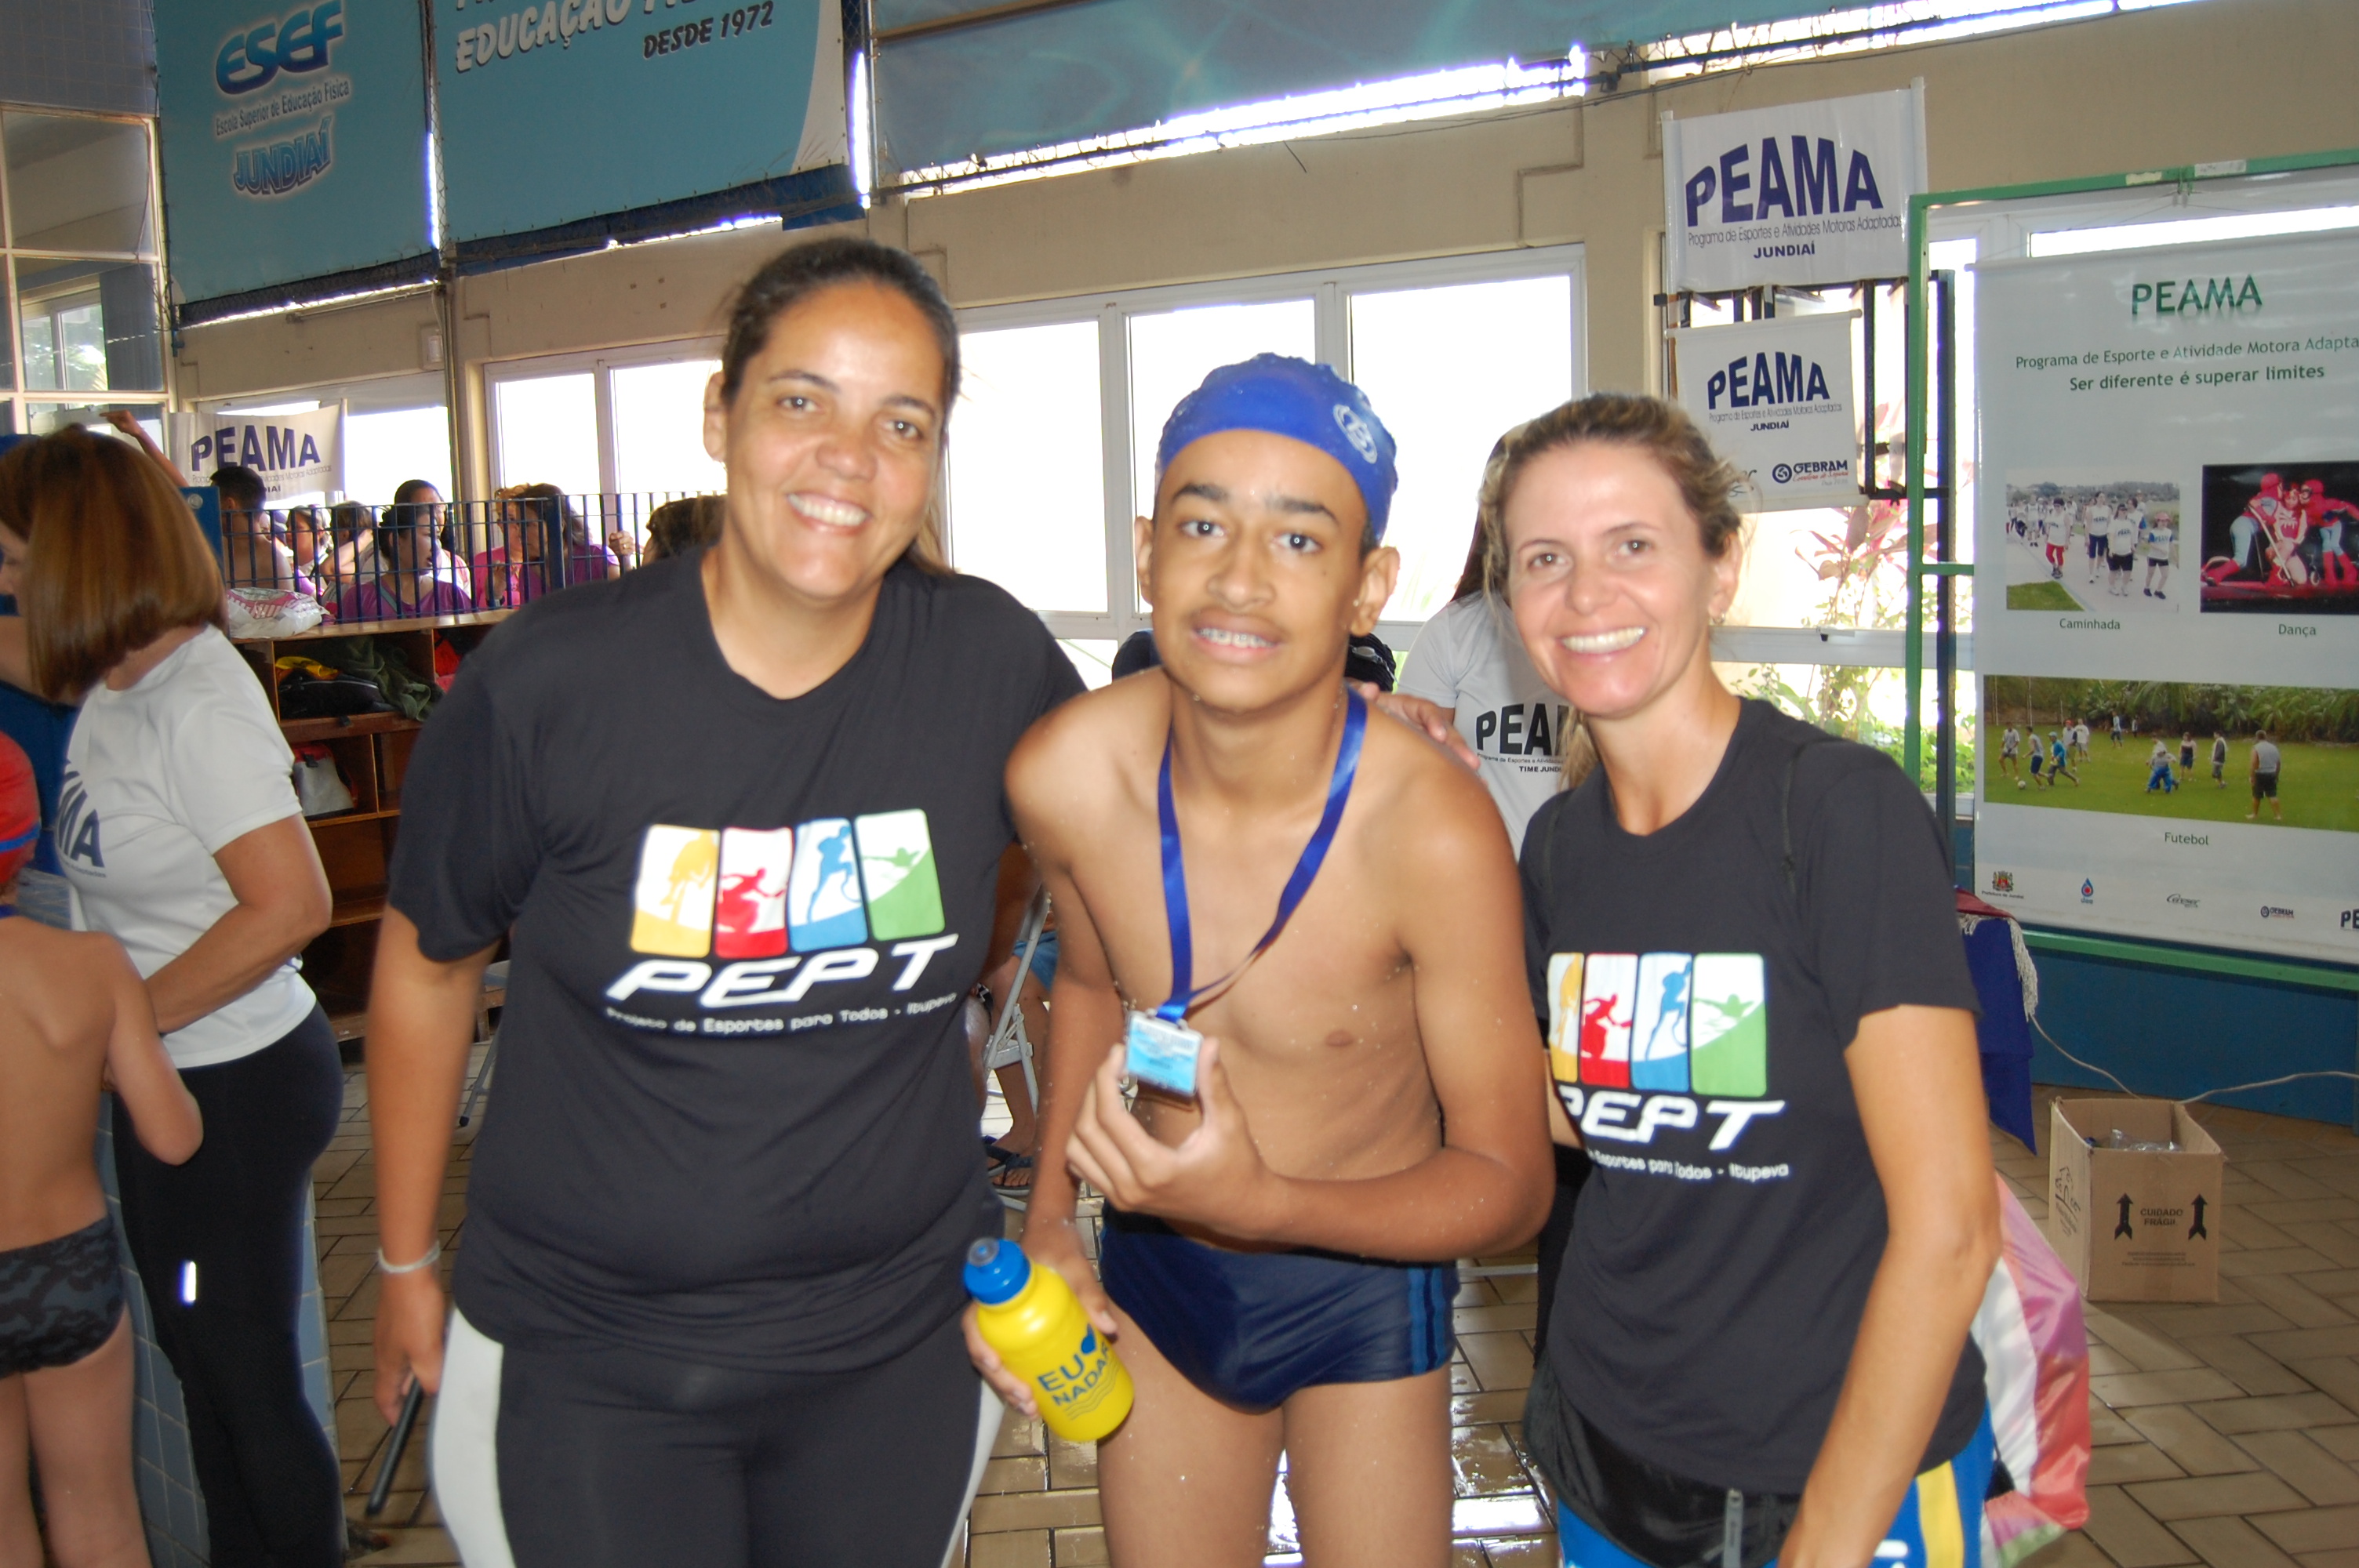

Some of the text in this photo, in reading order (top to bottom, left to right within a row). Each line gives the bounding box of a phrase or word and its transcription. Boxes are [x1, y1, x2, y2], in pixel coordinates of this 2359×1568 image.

[643, 1, 774, 59] DESDE 1972
[216, 0, 343, 95] ESEF
[216, 118, 238, 136] Escola
[239, 103, 269, 129] Superior
[271, 100, 280, 117] de
[282, 88, 322, 114] Educação
[234, 115, 332, 194] JUNDIAÍ
[1685, 135, 1884, 227] PEAMA
[1688, 214, 1902, 249] Programa de Esportes e Atividades Motoras Adaptadas
[1754, 241, 1815, 259] JUNDIAÍ
[2132, 274, 2263, 314] PEAMA
[2016, 355, 2077, 370] Programa
[2083, 352, 2099, 365] de
[2103, 350, 2155, 365] Esporte
[2161, 350, 2168, 359] e
[2173, 343, 2242, 358] Atividade
[2248, 340, 2300, 354] Motora
[1707, 351, 1830, 410] PEAMA
[2070, 365, 2325, 391] Ser diferente é superar limites
[1750, 419, 1789, 431] JUNDIAÍ
[191, 424, 321, 473] PEAMA
[1793, 459, 1848, 474] GEBRAM
[2059, 618, 2121, 630] Caminhada
[2278, 623, 2317, 638] Dança
[2164, 832, 2209, 846] Futebol
[605, 933, 959, 1008] PEPT
[674, 1018, 696, 1032] de
[703, 1018, 784, 1035] Esportes
[791, 1014, 834, 1031] para
[839, 1007, 889, 1022] Todos
[1728, 1162, 1789, 1182] Itupeva
[2140, 1208, 2183, 1217] CUIDADO
[1038, 1354, 1085, 1392] EU
